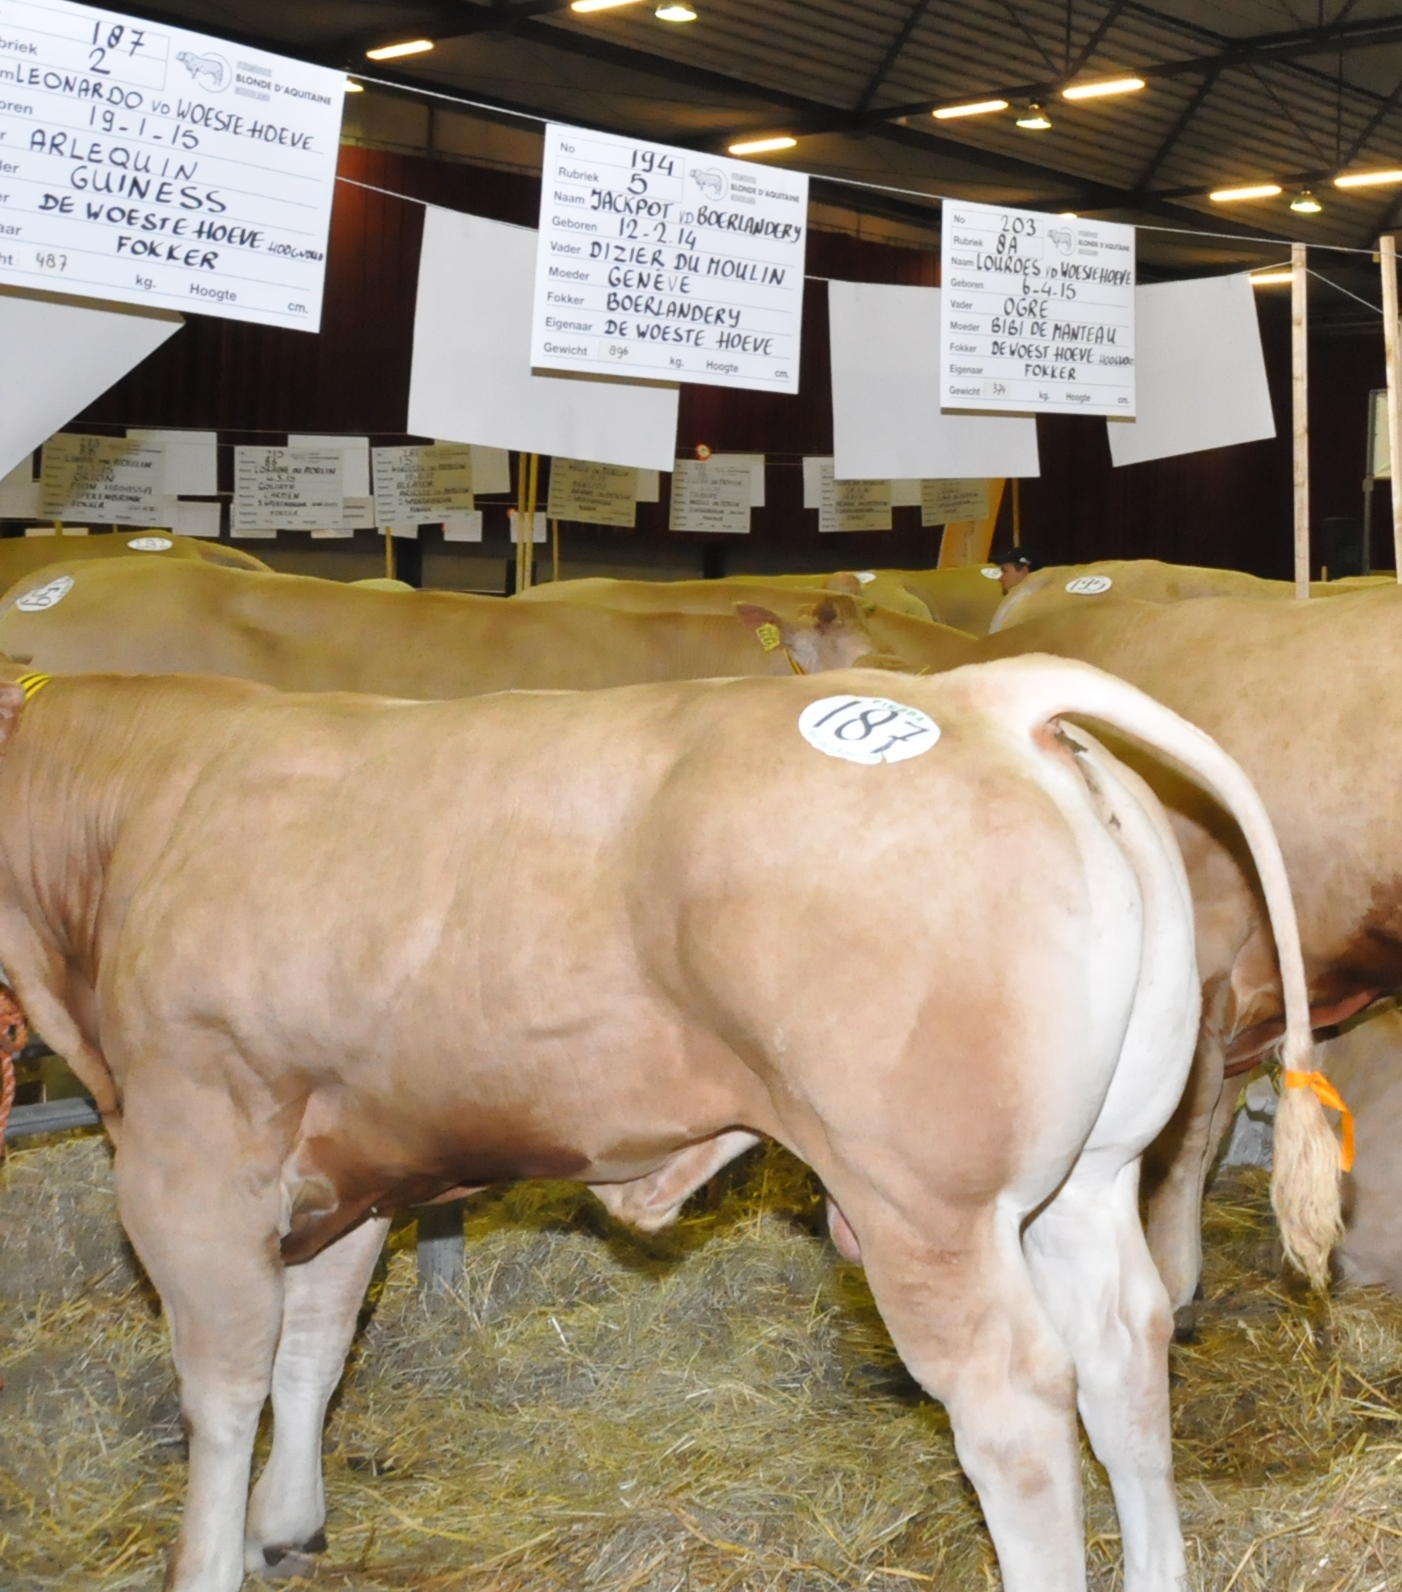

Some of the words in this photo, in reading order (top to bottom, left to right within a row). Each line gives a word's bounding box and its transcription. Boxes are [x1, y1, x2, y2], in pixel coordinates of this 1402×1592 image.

[91, 20, 145, 56] 187
[88, 47, 110, 75] 2
[236, 73, 271, 90] BLONDE
[274, 83, 332, 105] D'AQUITAINE
[16, 63, 143, 109] LEONARDO
[176, 98, 243, 135] WOESTE
[247, 120, 313, 150] HOEVE
[30, 128, 198, 180] ARLEQUIN
[560, 142, 575, 153] No
[631, 150, 674, 176] 194
[70, 166, 226, 213] GUINESS
[558, 167, 599, 182] Rubriek
[626, 173, 648, 195] 5
[731, 183, 756, 195] BLONDE
[38, 193, 74, 213] DE
[86, 203, 188, 236] WOESTE
[193, 220, 265, 249] HOEVE
[552, 216, 597, 232] Geboren
[554, 191, 585, 205] Naam
[590, 189, 674, 219] JACKPOT
[696, 205, 802, 244] BOERLANDERY
[954, 215, 965, 224] No
[1001, 215, 1036, 236] 203
[117, 235, 219, 270] FOKKER
[953, 236, 983, 247] Rubriek
[996, 233, 1018, 254] 8A
[548, 266, 590, 281] Moeder
[551, 241, 581, 254] Vader
[589, 241, 665, 268] DIZIER
[673, 252, 700, 273] DU
[707, 257, 785, 285] MOULIN
[951, 257, 974, 267] Naam
[976, 253, 1041, 277] LOURDES
[35, 254, 67, 272] 487
[135, 275, 156, 290] kg.
[190, 283, 237, 302] Hoogte
[288, 301, 309, 314] cm.
[950, 278, 984, 289] Geboren
[547, 292, 584, 305] Fokker
[606, 292, 741, 327] BOERLANDERY
[950, 300, 973, 310] Vader
[1003, 297, 1049, 319] OGRE
[545, 317, 593, 332] Eigenaar
[604, 319, 628, 337] DE
[636, 324, 705, 346] WOESTE
[715, 331, 774, 355] HOEVE
[950, 321, 980, 332] Moeder
[1030, 321, 1048, 338] DE
[1052, 323, 1116, 346] MANTEAU
[544, 342, 588, 357] Gewicht
[706, 360, 739, 374] Hoogte
[950, 343, 977, 353] Fokker
[991, 340, 1007, 356] DE
[1053, 346, 1095, 364] HOEVE
[949, 364, 983, 376] Eigenaar
[1024, 363, 1076, 381] FOKKER
[949, 385, 980, 397] Gewicht
[1066, 393, 1091, 404] Hoogte
[812, 700, 930, 754] 187
